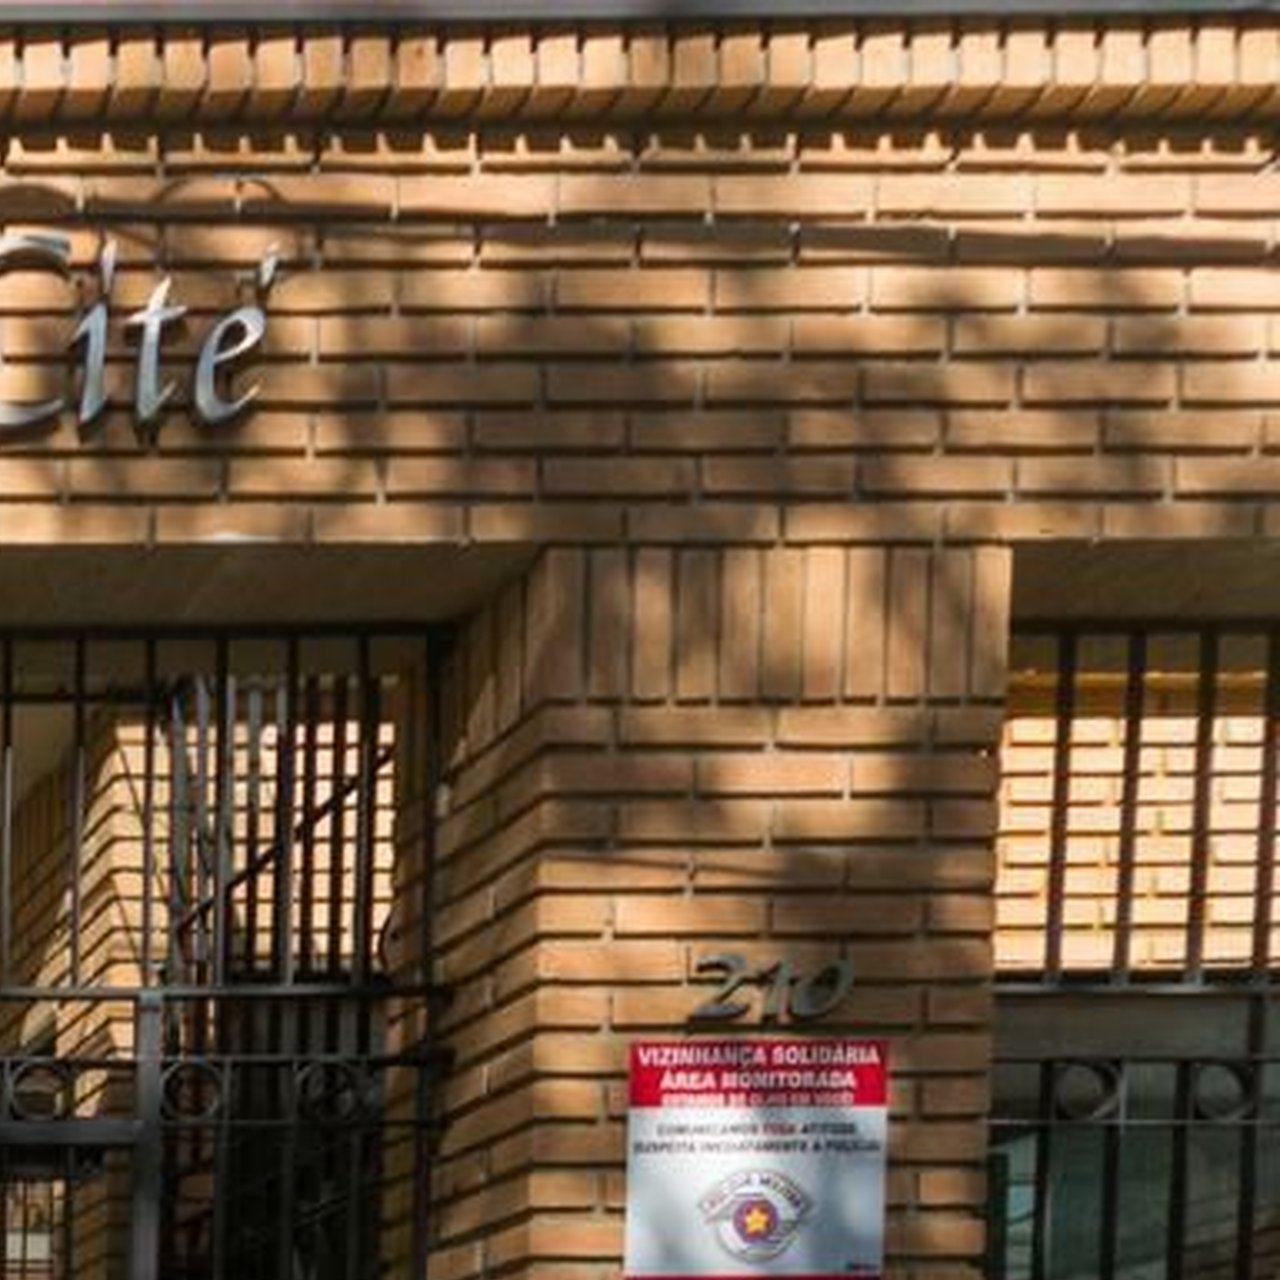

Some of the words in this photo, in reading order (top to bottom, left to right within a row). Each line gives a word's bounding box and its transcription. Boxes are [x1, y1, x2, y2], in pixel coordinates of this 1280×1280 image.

[692, 953, 854, 1019] 210
[638, 1045, 767, 1068] VIZINHANÇA
[771, 1043, 881, 1065] SOLIDÁRIA
[661, 1067, 717, 1090] ÁREA
[721, 1069, 857, 1090] MONITORADA
